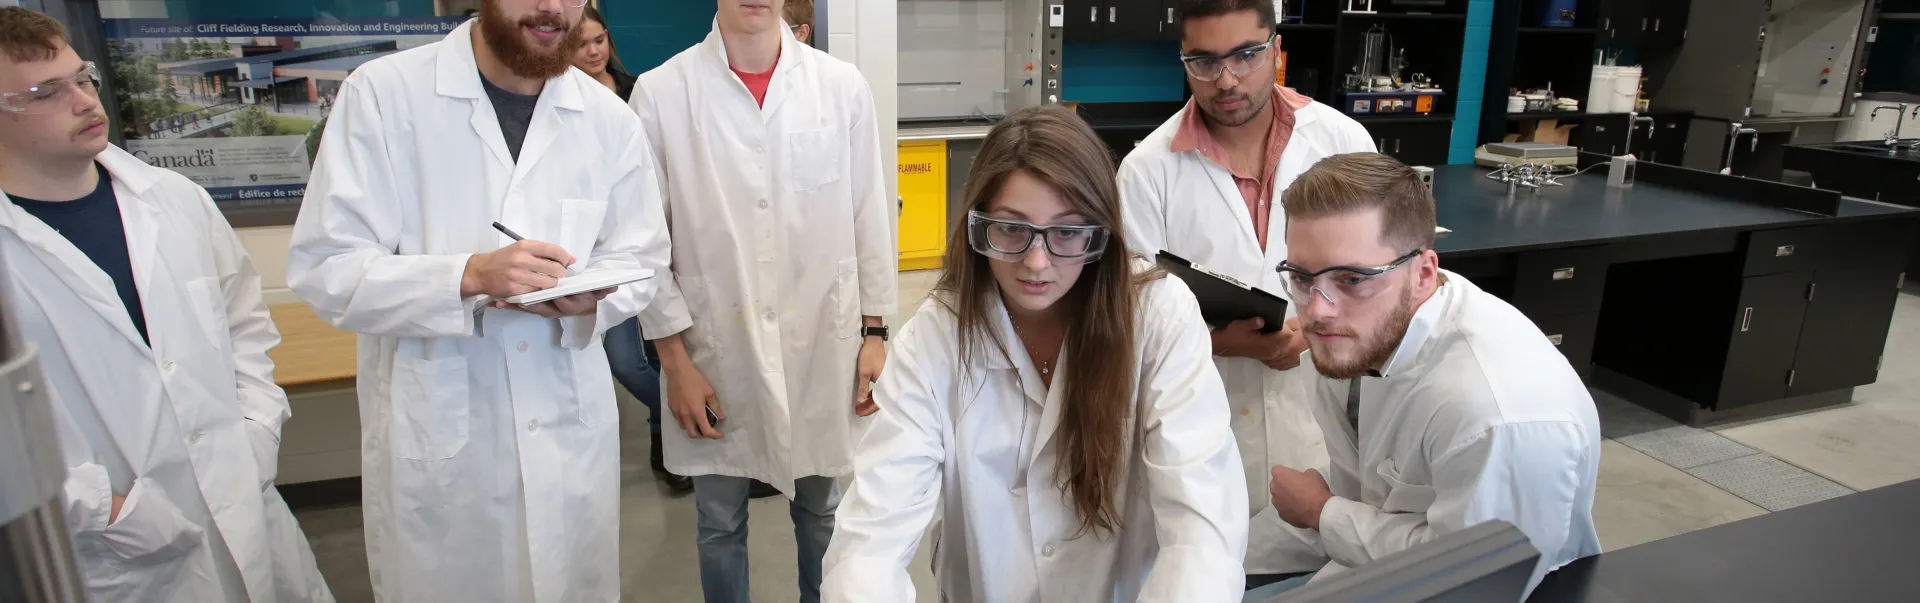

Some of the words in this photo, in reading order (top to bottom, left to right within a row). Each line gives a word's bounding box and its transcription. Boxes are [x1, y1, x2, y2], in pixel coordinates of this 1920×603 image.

[141, 25, 165, 33] Future
[168, 25, 182, 33] site
[197, 24, 217, 33] Cliff
[220, 24, 259, 34] Fielding
[261, 23, 307, 33] Research,
[309, 22, 361, 32] Innovation
[363, 22, 381, 32] and
[384, 21, 438, 33] Engineering
[132, 149, 216, 168] Canada
[898, 163, 931, 173] FLAMMABLE
[239, 188, 271, 199] Édifice
[273, 189, 285, 198] de
